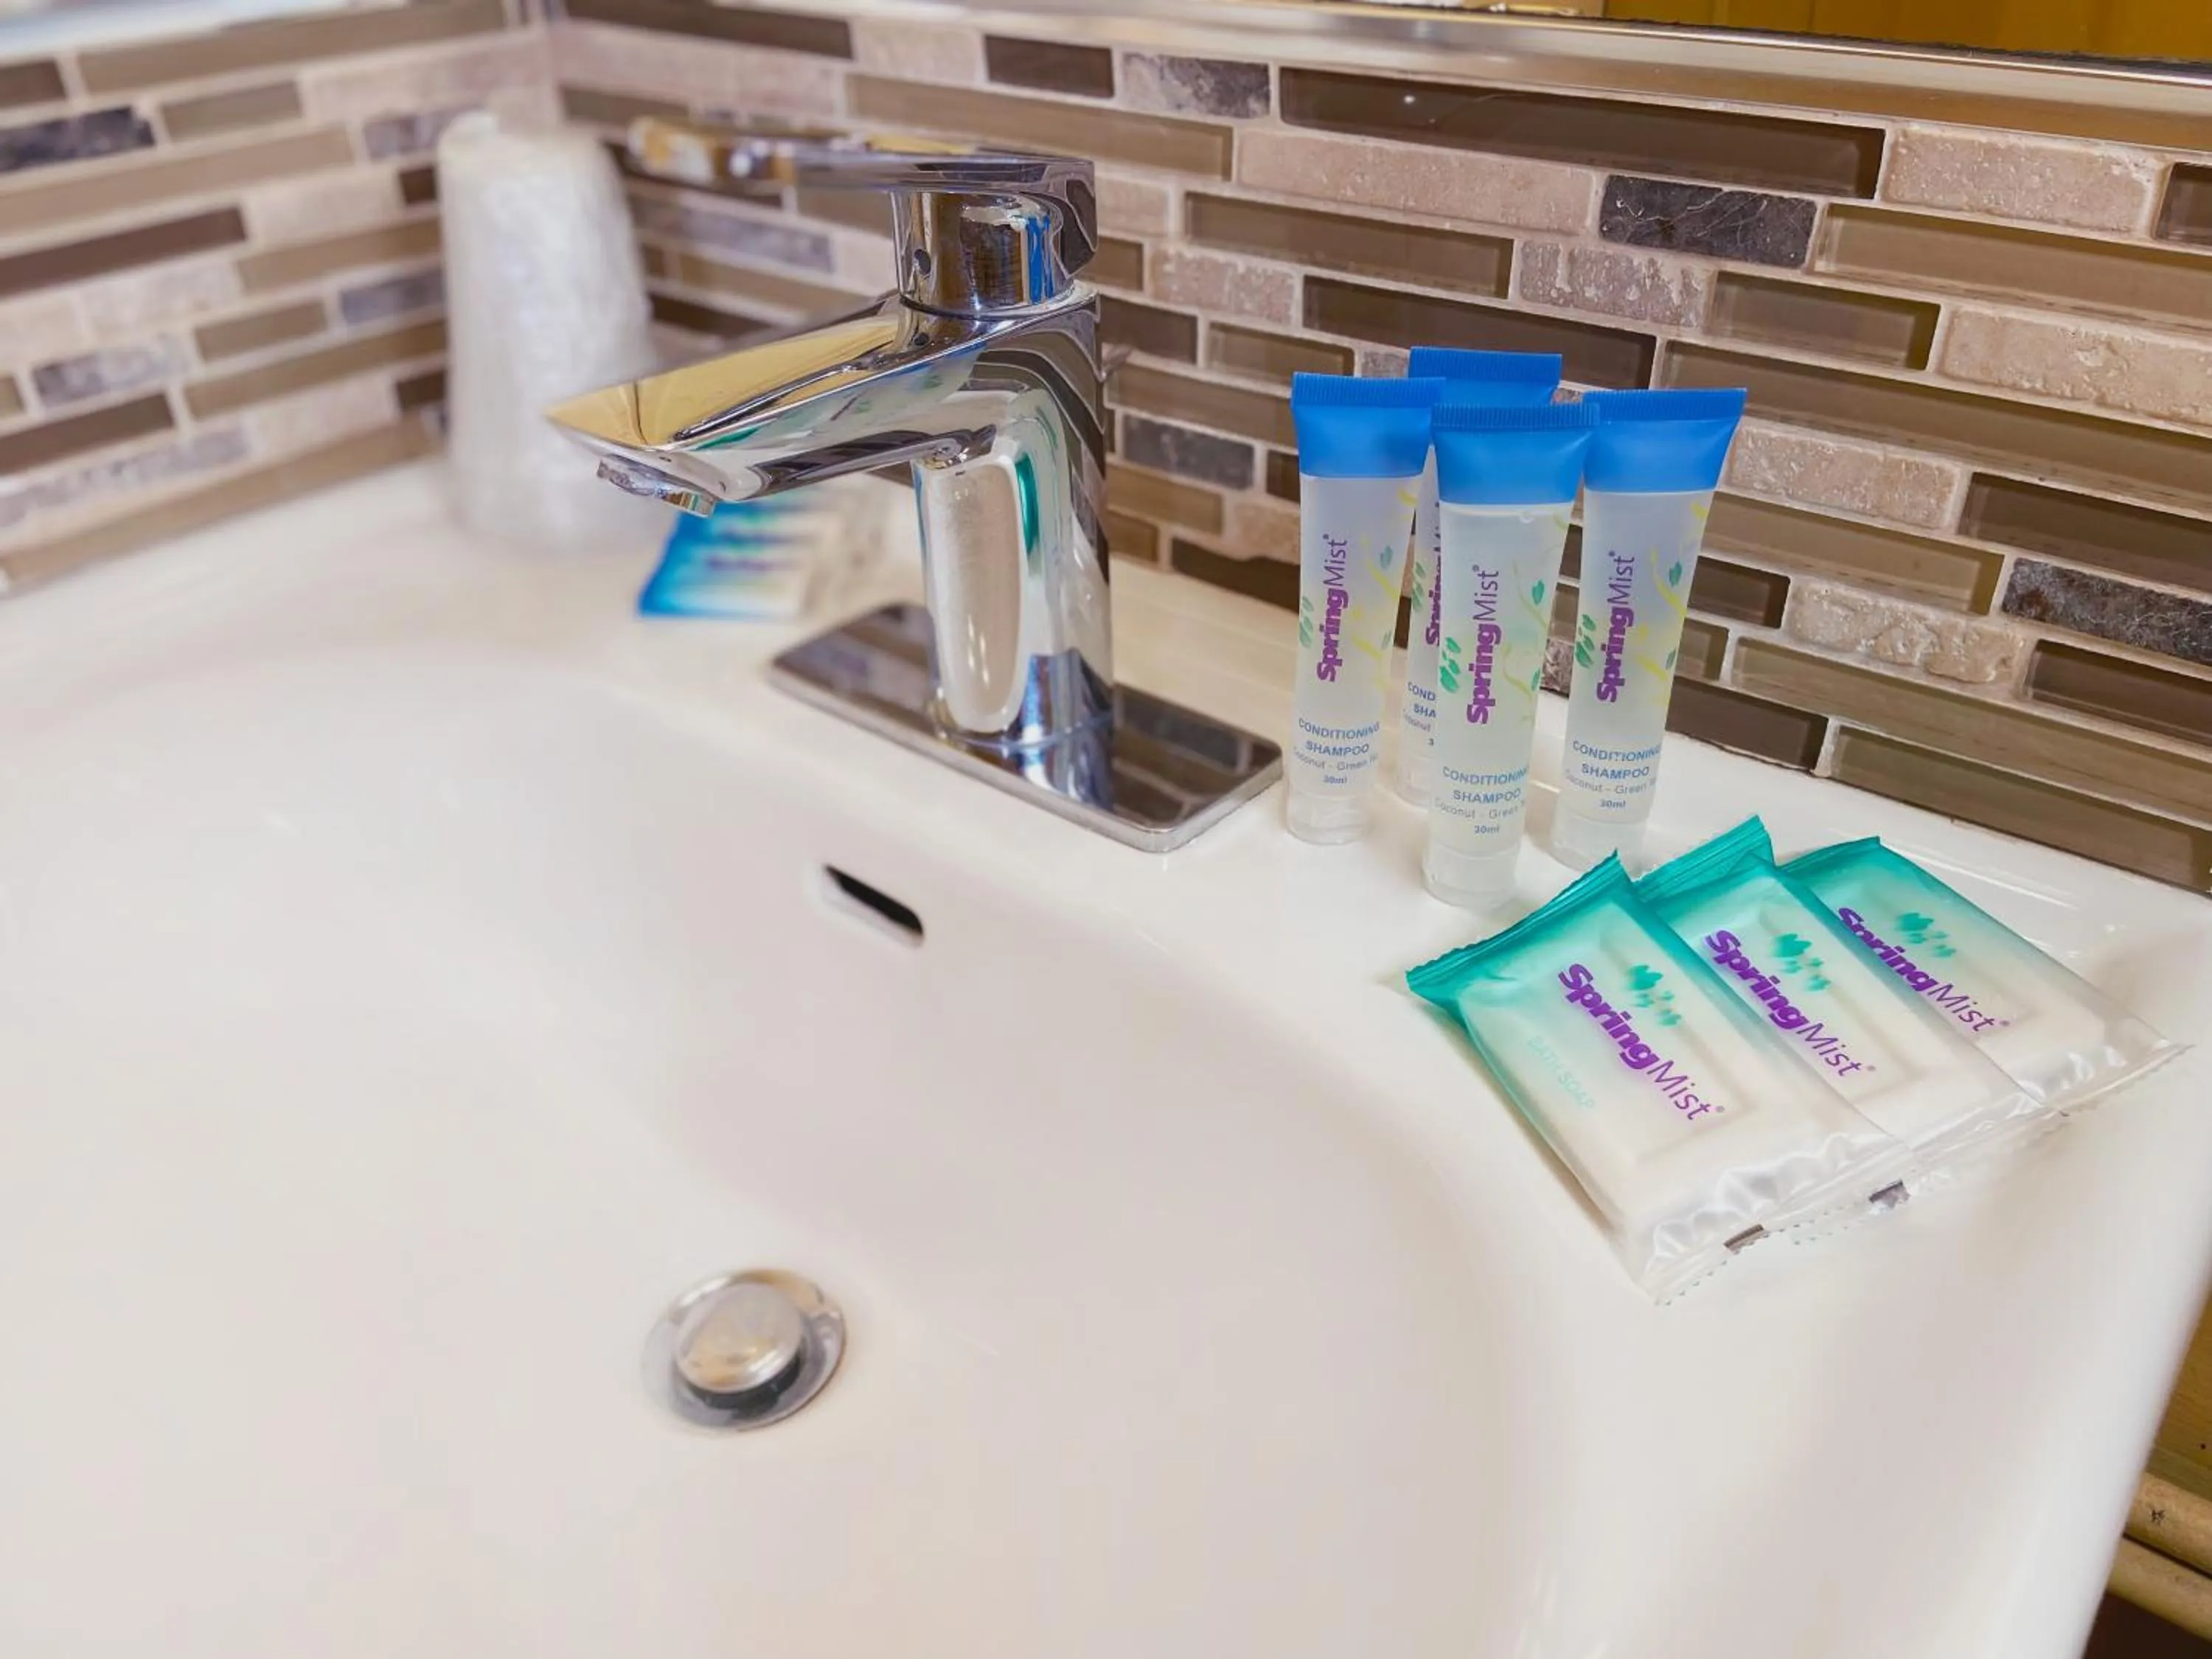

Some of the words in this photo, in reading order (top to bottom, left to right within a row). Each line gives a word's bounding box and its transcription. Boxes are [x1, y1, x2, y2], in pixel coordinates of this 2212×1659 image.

[1305, 740, 1370, 756] SHAMPOO
[1581, 762, 1650, 779] SHAMPOO
[1453, 787, 1522, 804] SHAMPOO
